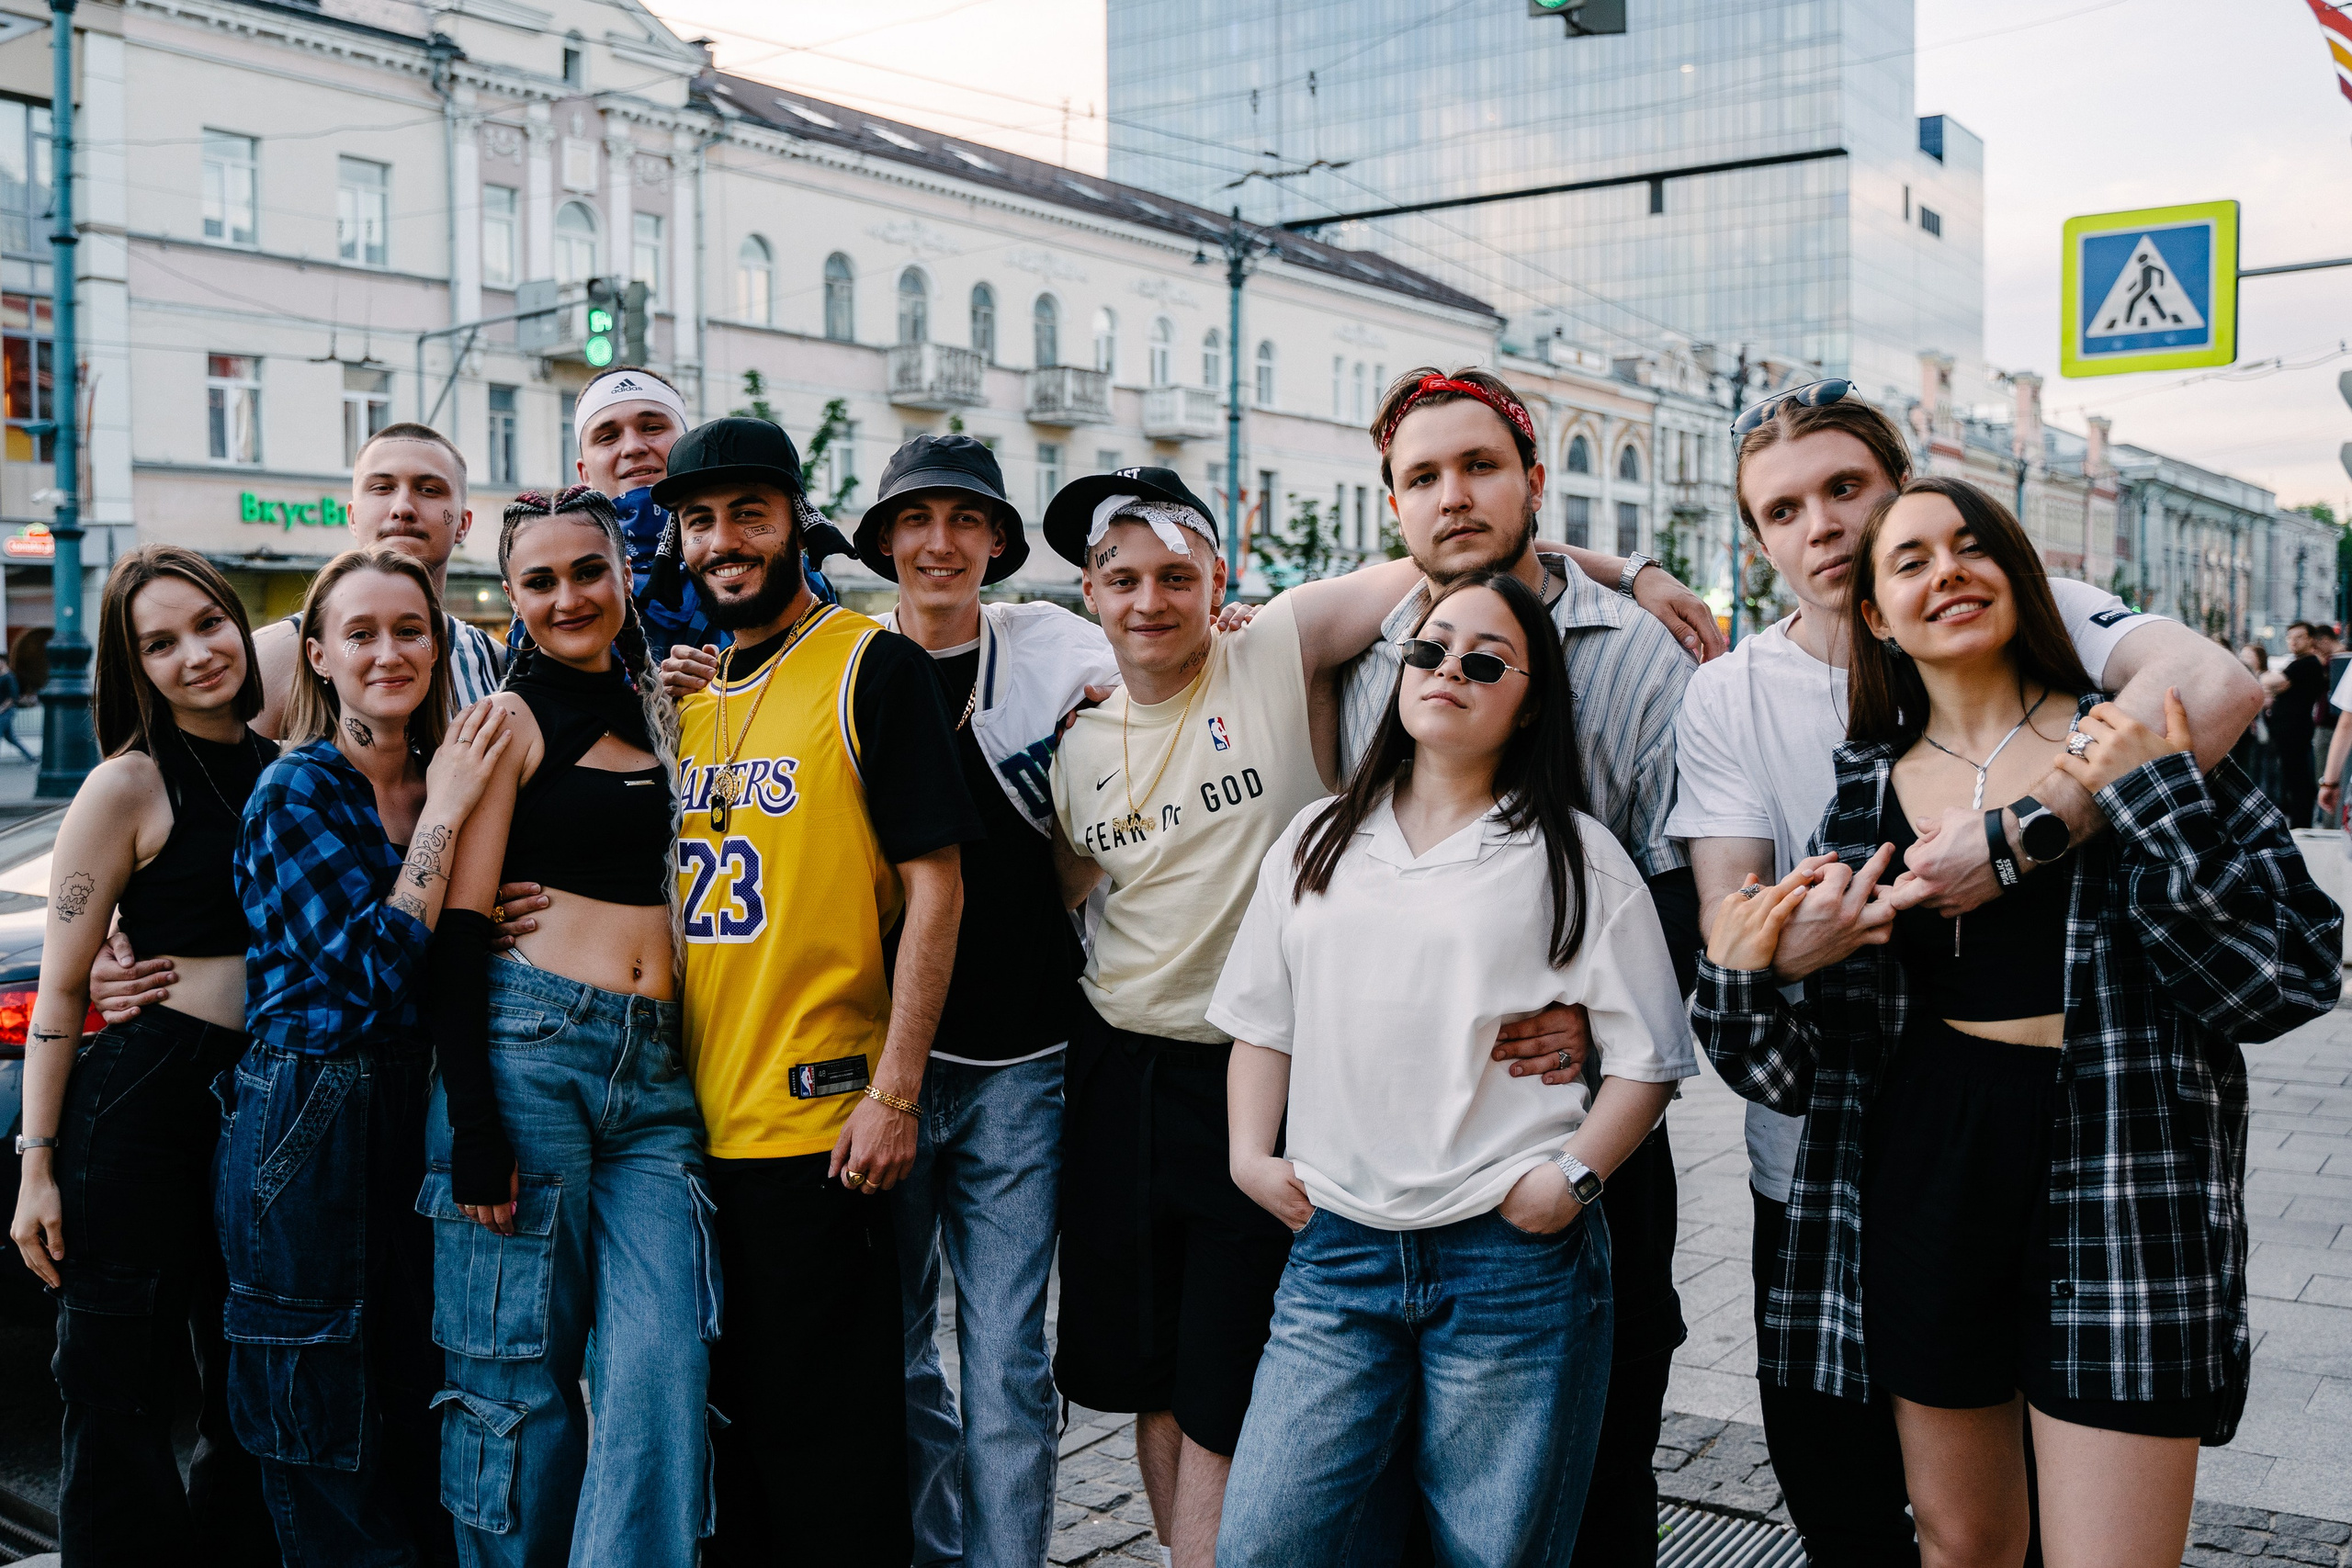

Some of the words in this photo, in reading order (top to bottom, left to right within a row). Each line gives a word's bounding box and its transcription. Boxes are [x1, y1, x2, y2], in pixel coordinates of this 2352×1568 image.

[611, 386, 643, 394] adidas
[1095, 546, 1118, 570] love
[1085, 812, 1148, 854] FEAR
[1200, 768, 1263, 813] GOD
[1996, 858, 2010, 885] PUBLICA
[2003, 858, 2018, 884] FITNESS
[678, 836, 768, 944] 23
